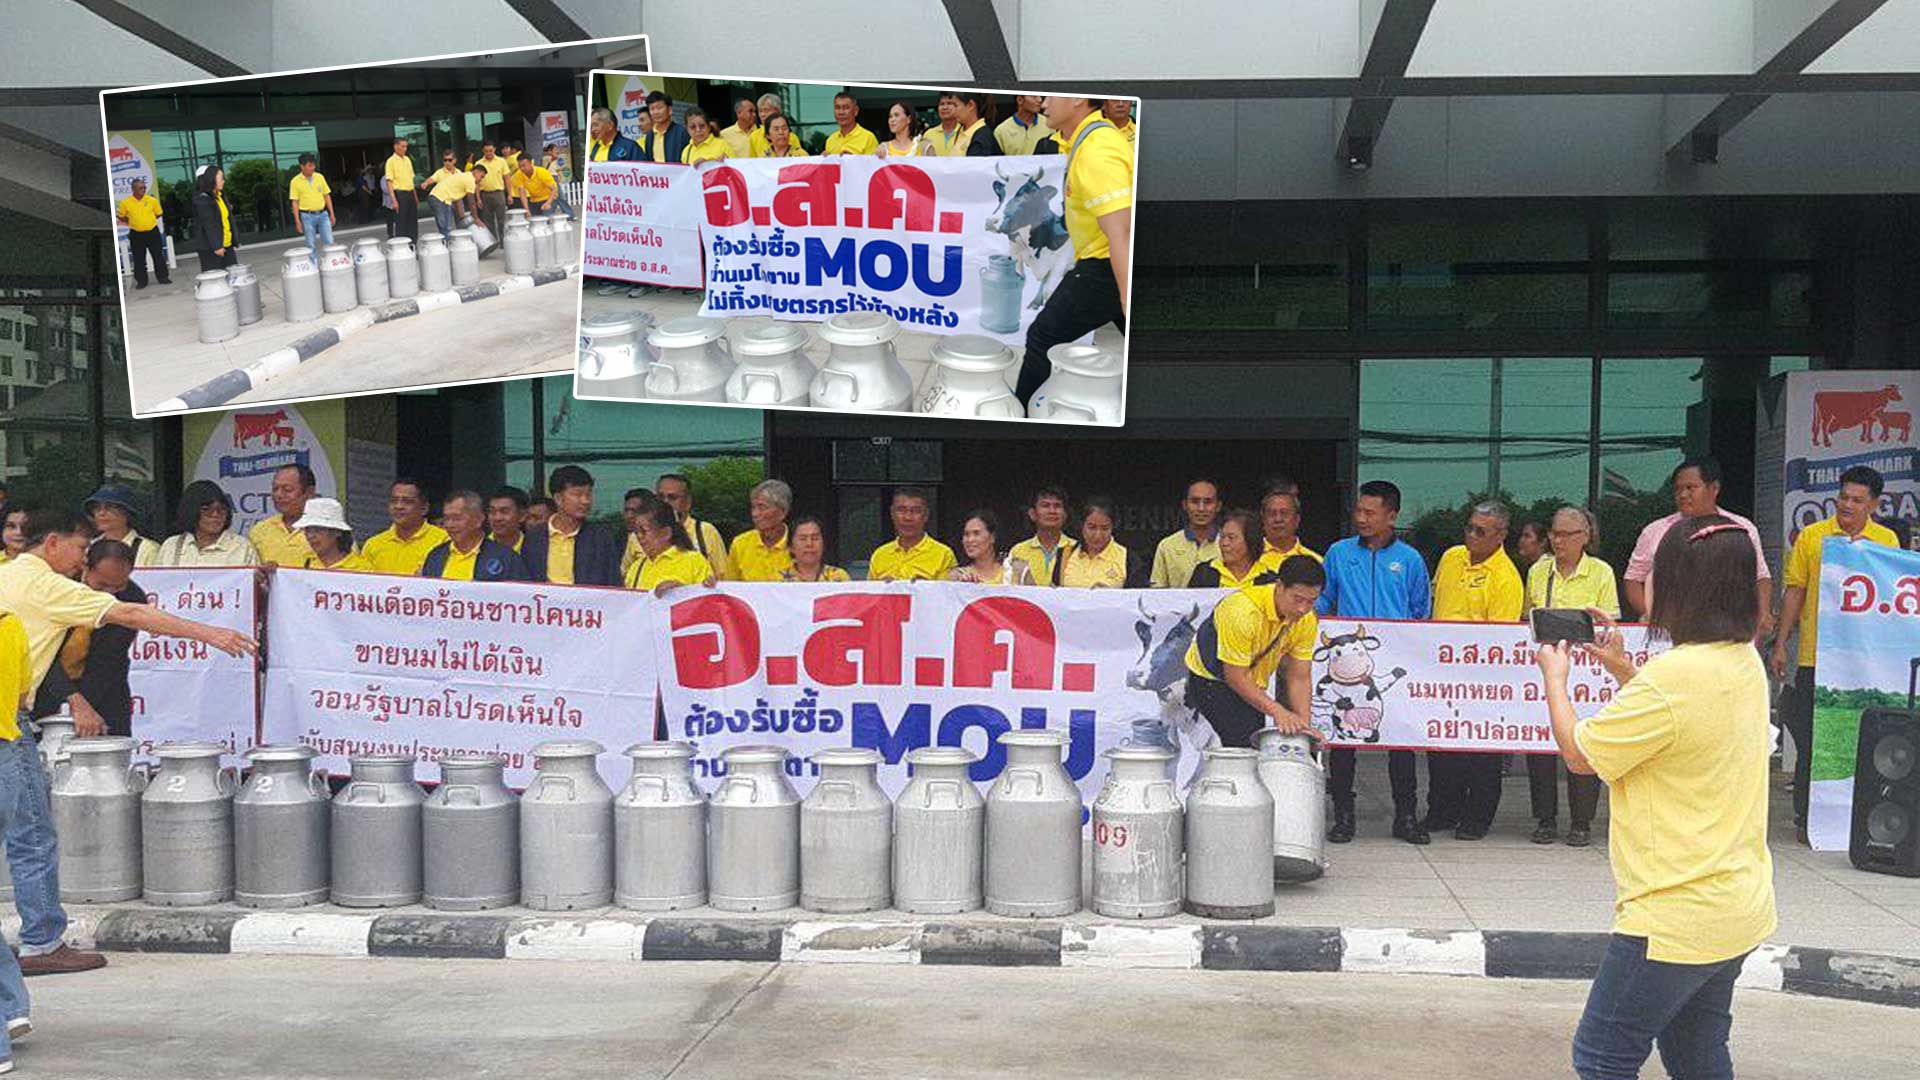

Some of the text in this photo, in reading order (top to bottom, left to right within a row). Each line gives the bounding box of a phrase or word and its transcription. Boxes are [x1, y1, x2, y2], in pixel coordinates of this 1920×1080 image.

[702, 163, 965, 234] อ.ส.ค.
[804, 237, 963, 297] MOU
[671, 593, 1095, 692] อ.ส.ค.
[685, 687, 844, 738] ต้องรับซื้อ
[852, 702, 1096, 782] MOU
[167, 775, 187, 793] 2
[255, 776, 273, 793] 2
